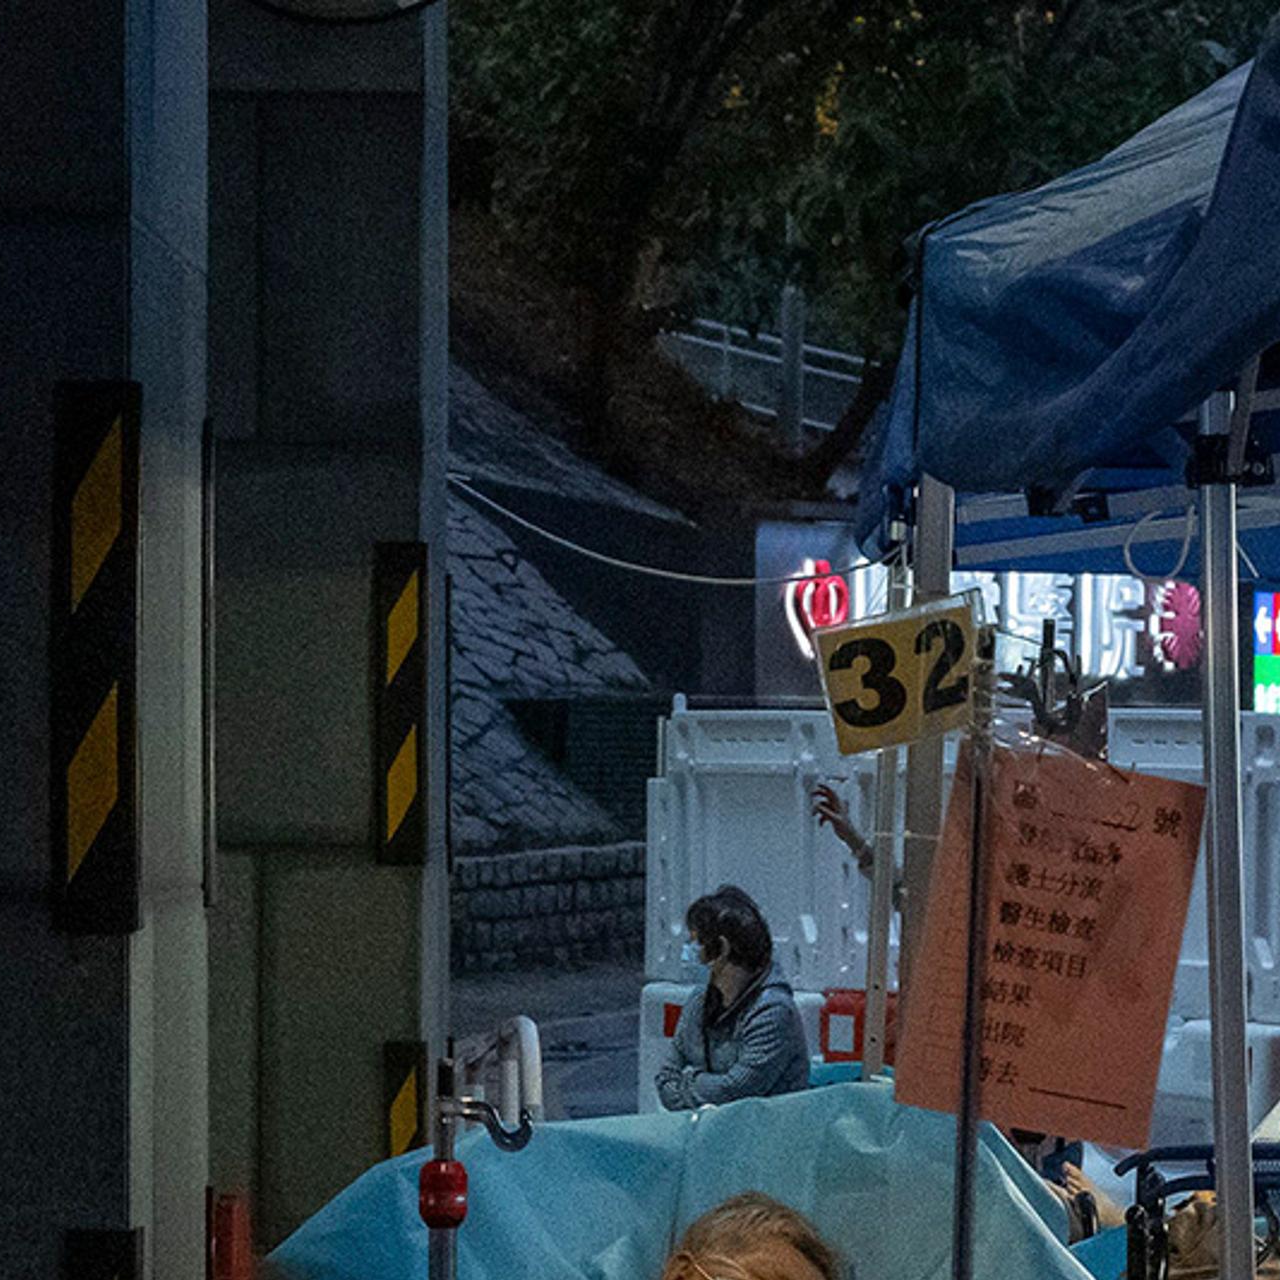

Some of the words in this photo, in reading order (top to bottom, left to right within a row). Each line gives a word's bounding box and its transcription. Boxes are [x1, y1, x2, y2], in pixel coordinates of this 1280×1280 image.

[829, 619, 969, 728] 32
[1005, 862, 1104, 902] 護士分流
[1000, 901, 1098, 940] 醫生檢查
[993, 939, 1087, 979] 檢查項目
